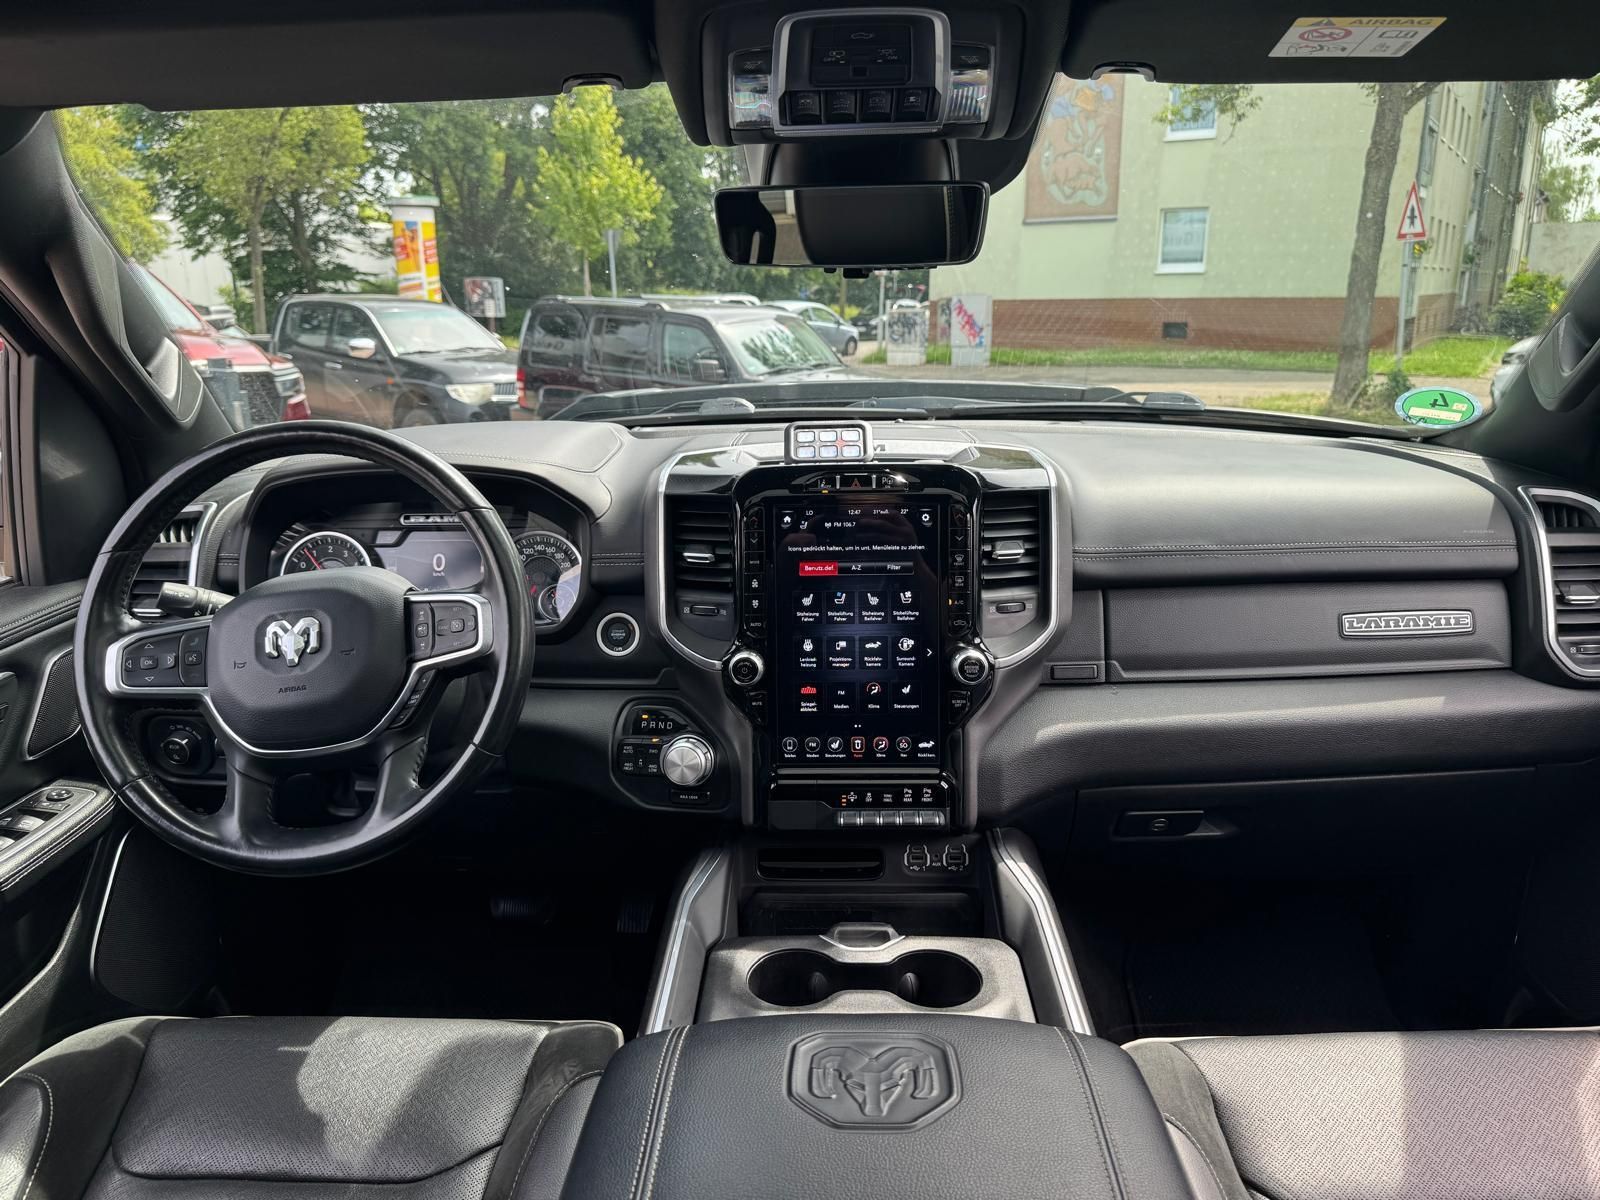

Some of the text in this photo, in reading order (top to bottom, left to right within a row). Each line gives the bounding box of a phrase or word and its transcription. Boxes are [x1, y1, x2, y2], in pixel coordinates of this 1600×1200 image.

[1350, 18, 1433, 26] AIRBAG
[405, 515, 461, 523] RAM
[802, 545, 825, 553] gedrückt
[433, 553, 445, 571] 0
[1345, 615, 1470, 631] LARAMIE
